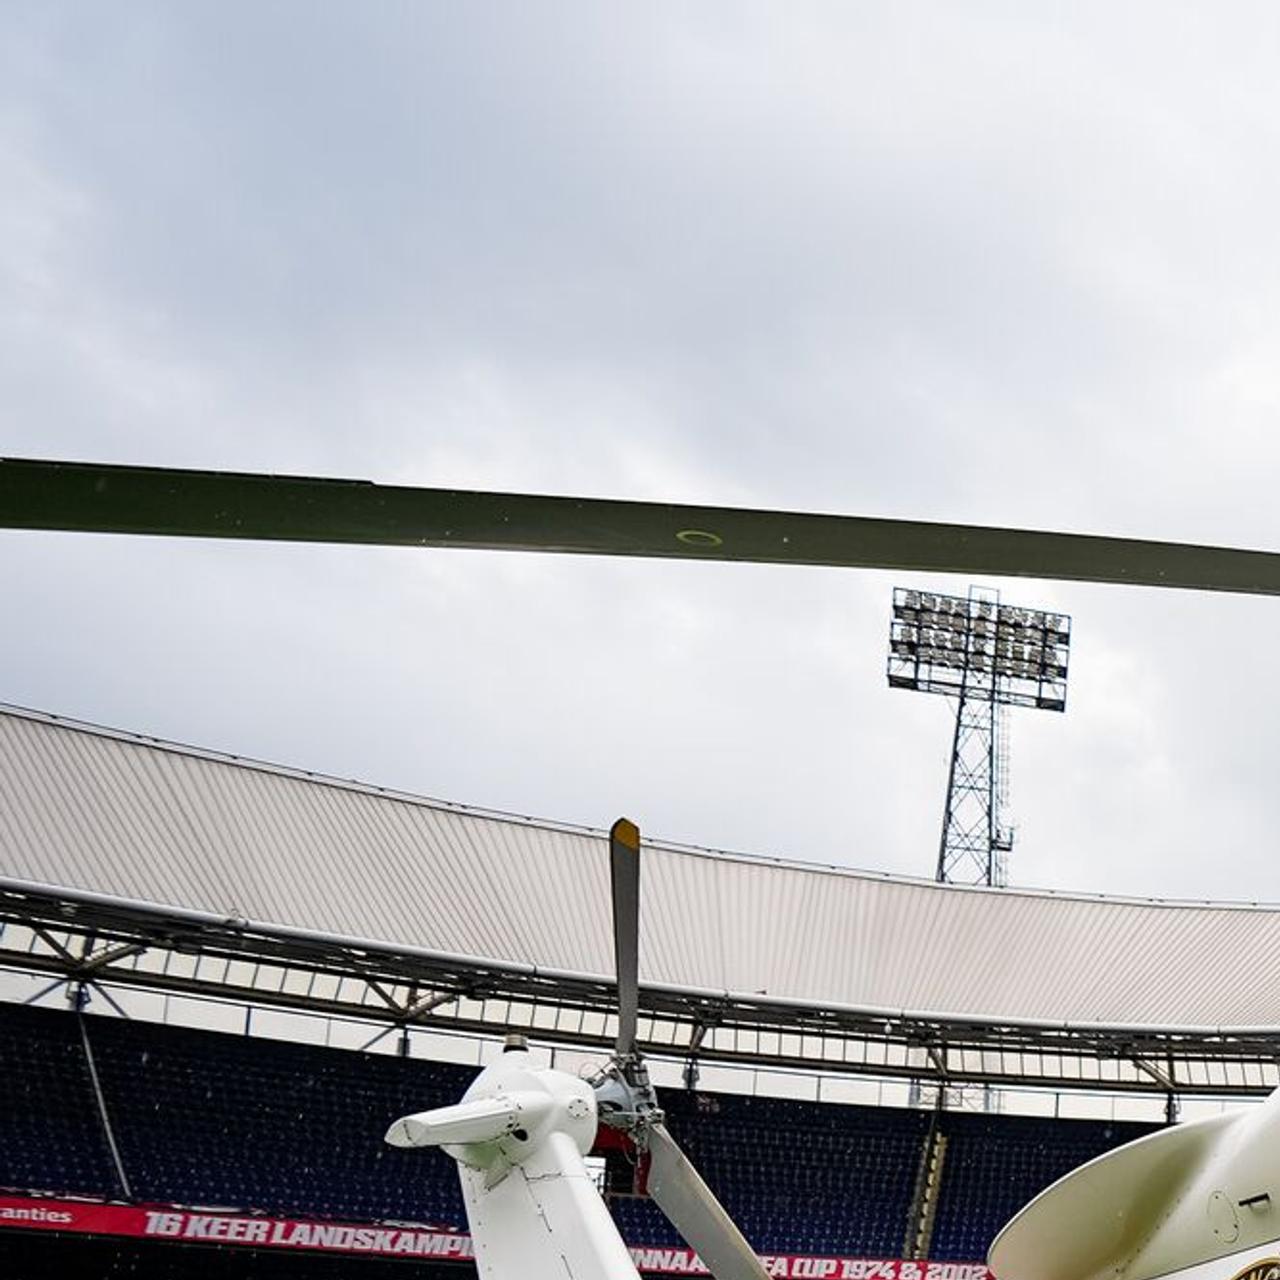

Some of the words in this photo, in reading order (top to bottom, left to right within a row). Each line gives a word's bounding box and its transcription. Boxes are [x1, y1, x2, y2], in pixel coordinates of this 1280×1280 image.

[0, 1206, 73, 1223] anties
[145, 1211, 184, 1236] 16
[182, 1214, 271, 1242] KEER
[791, 1258, 838, 1279] CUP
[840, 1260, 896, 1280] 1974
